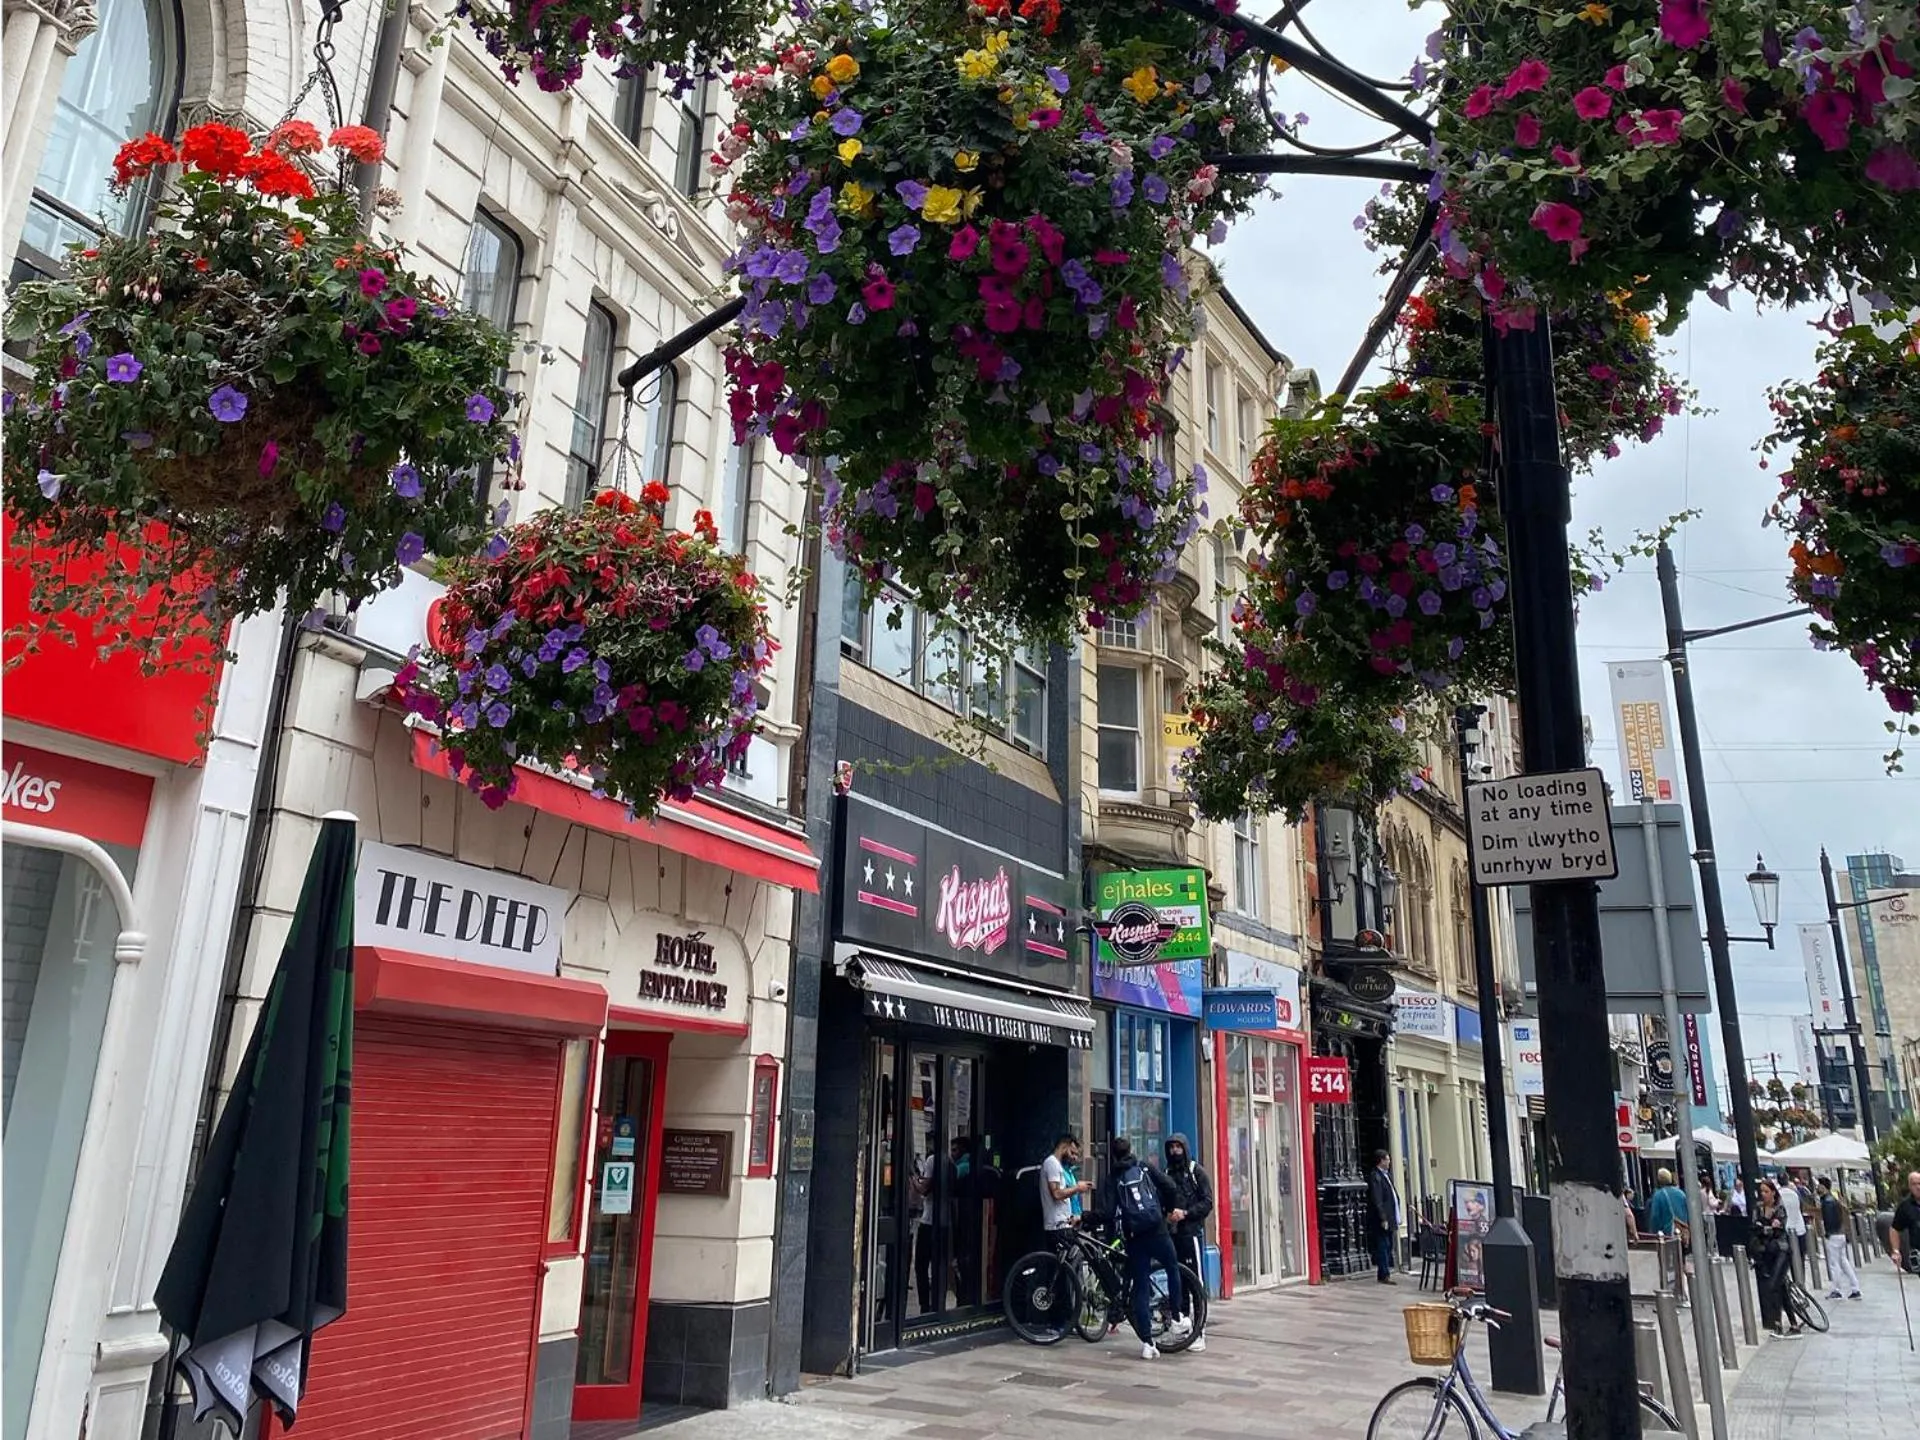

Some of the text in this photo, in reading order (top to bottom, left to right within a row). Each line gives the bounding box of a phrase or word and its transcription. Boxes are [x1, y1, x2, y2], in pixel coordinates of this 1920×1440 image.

[1623, 705, 1634, 729] THE
[1649, 704, 1664, 748] WELSH
[1627, 732, 1641, 766] YEAR
[1635, 704, 1653, 778] UNIVERSITY
[1482, 779, 1587, 802] No loading
[1481, 800, 1593, 822] at any time
[1482, 827, 1600, 850] Dim llwytho
[1482, 850, 1607, 875] unrhyw bryd
[1103, 878, 1174, 905] ejhales
[375, 868, 550, 953] THE DEEP
[937, 864, 1011, 950] Kaspa's
[1108, 920, 1160, 945] Kaspa's
[654, 933, 718, 975] HOTEL
[639, 969, 727, 1009] ENTRANCE
[1400, 996, 1437, 1006] TESCO
[934, 1005, 952, 1027] THE
[1209, 1002, 1272, 1013] EDWARDS
[1401, 1010, 1436, 1021] express
[1311, 1073, 1345, 1093] £14
